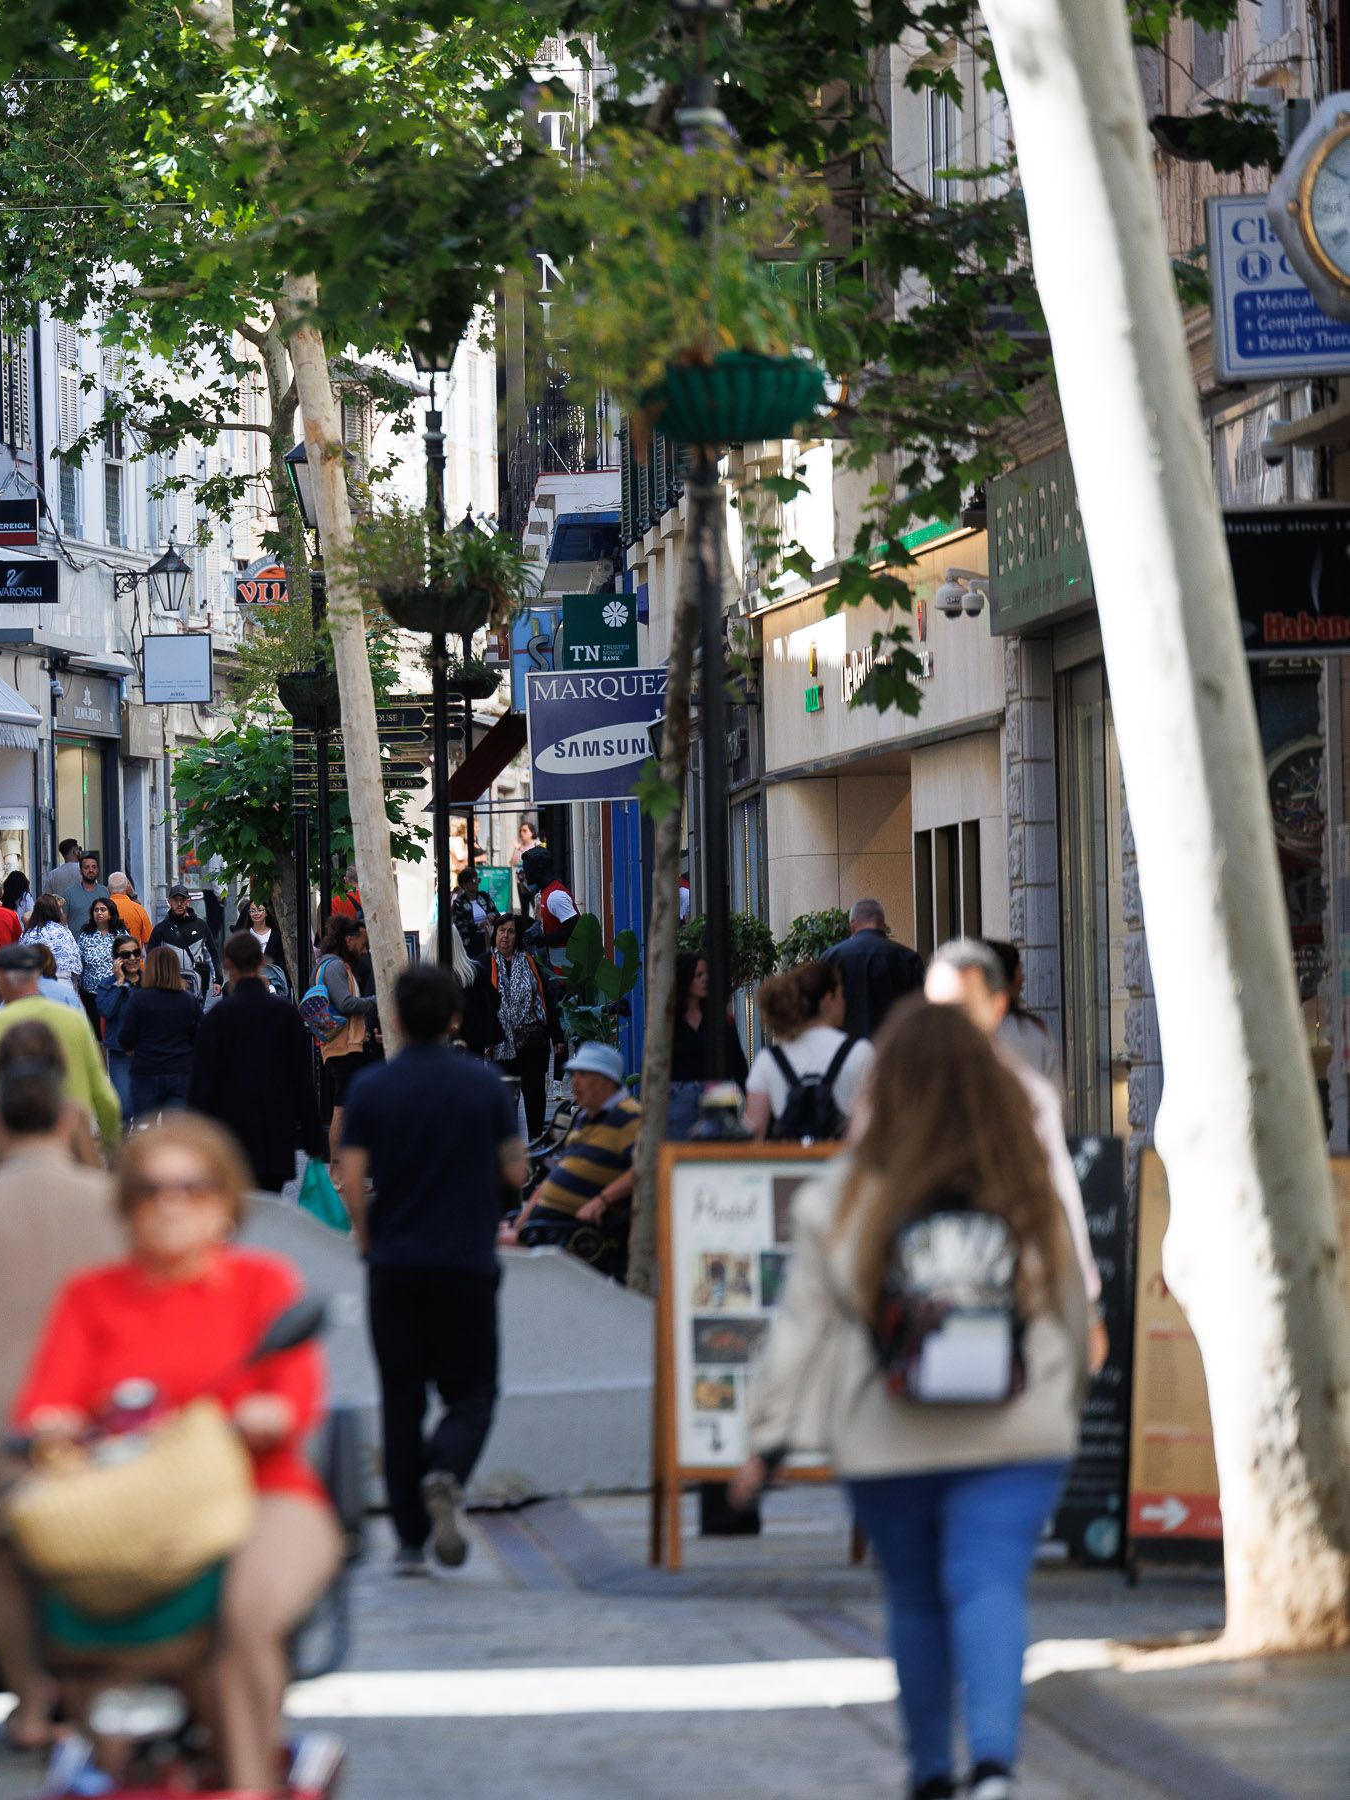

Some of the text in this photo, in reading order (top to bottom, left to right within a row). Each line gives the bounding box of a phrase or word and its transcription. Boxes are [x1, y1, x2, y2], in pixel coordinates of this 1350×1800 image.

[1256, 292, 1315, 310] Medical
[1258, 333, 1312, 353] Beauty
[570, 645, 600, 662] TN
[533, 674, 670, 701] MARQUEZ
[376, 713, 399, 722] OUSE
[554, 738, 653, 759] SAMSUN
[311, 765, 340, 773] SPS
[396, 779, 422, 787] TOWN
